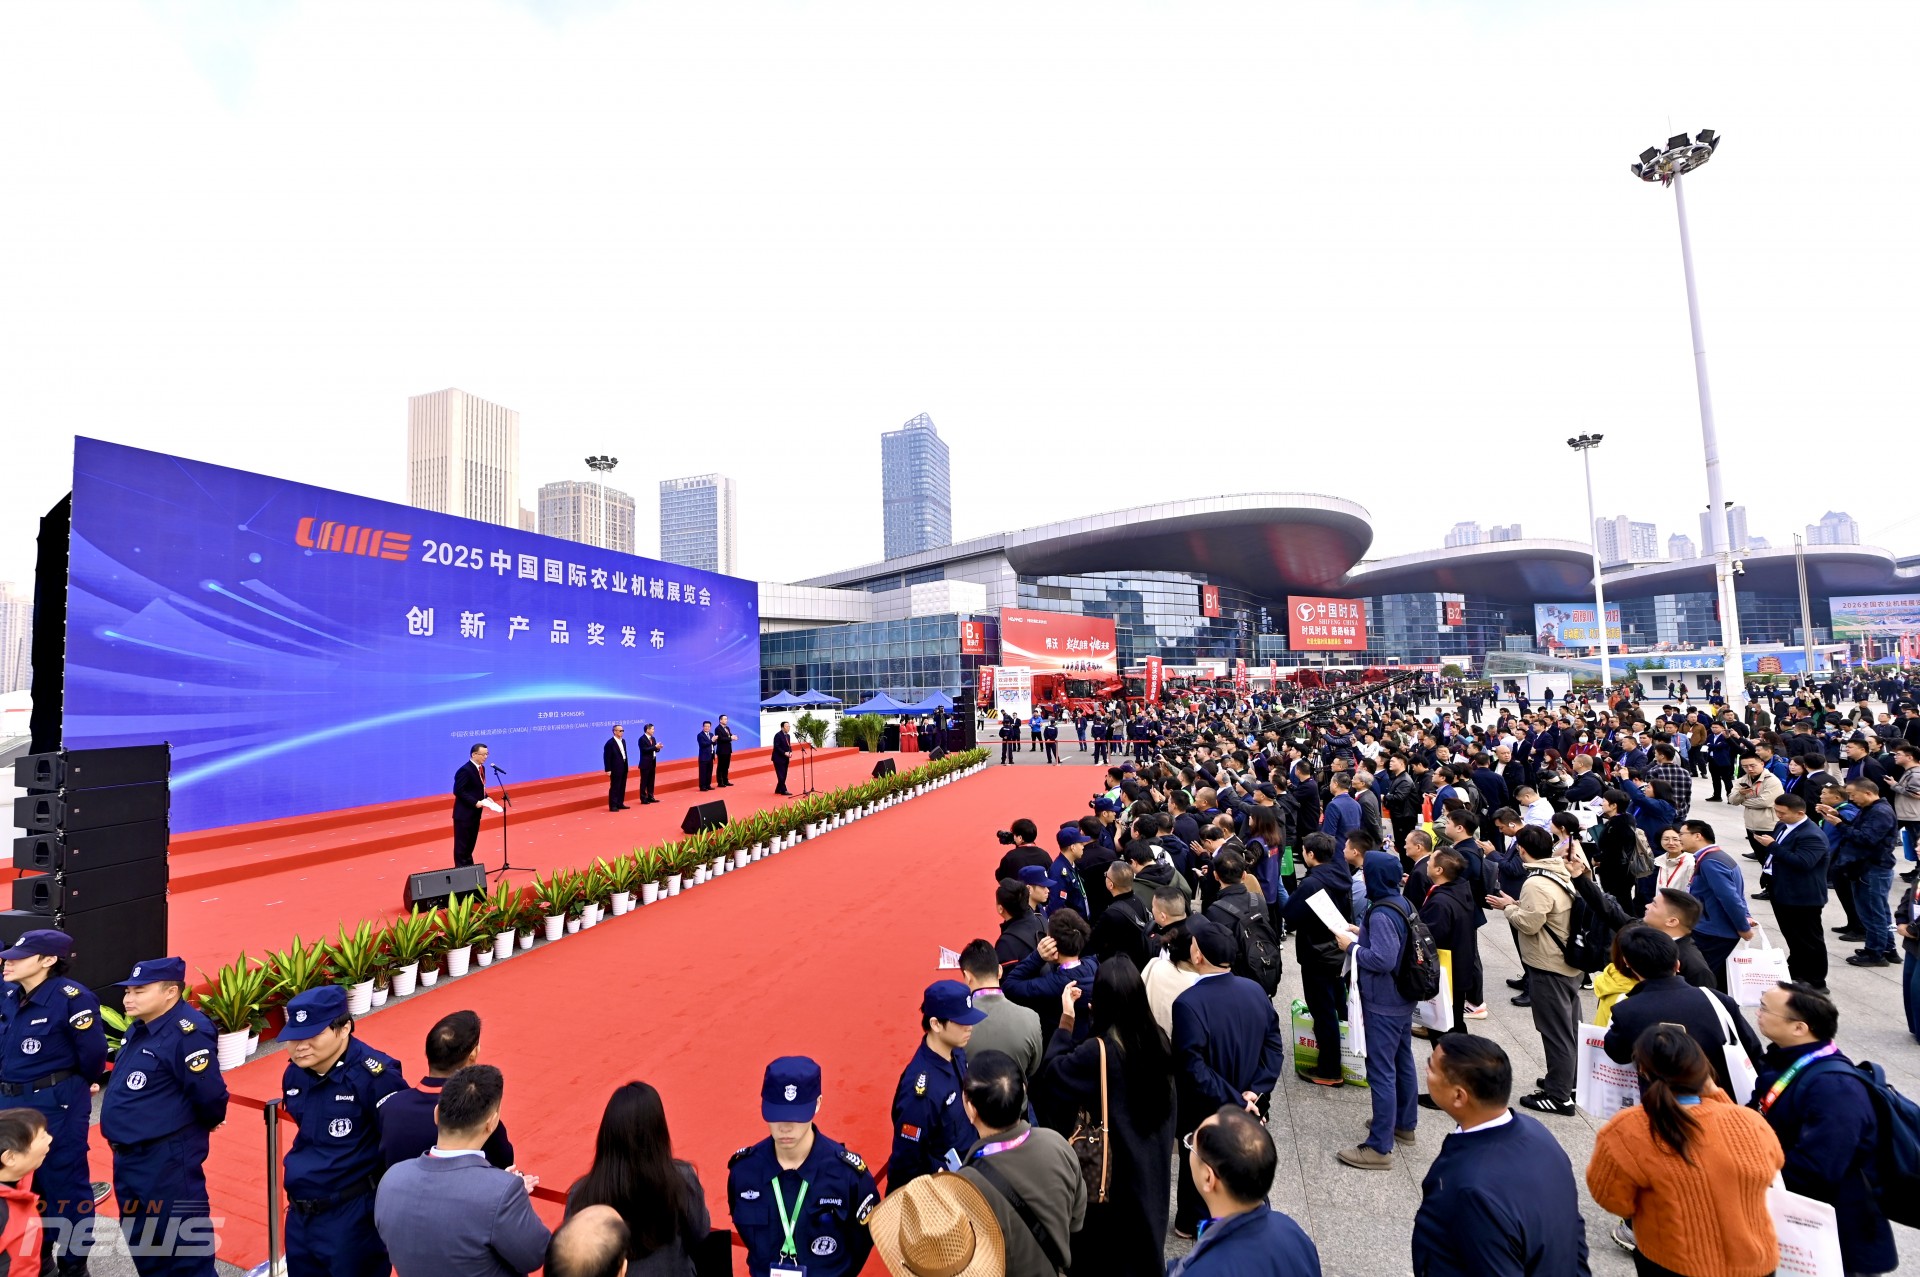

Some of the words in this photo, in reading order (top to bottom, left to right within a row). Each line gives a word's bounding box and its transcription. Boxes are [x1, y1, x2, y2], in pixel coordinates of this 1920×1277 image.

[1205, 593, 1218, 609] B1
[1316, 602, 1359, 619] 中国时风
[1447, 607, 1461, 620] B2
[405, 606, 666, 649] 创新产品奖发布
[1301, 625, 1328, 636] 时风时风
[1331, 626, 1356, 636] 路路畅通
